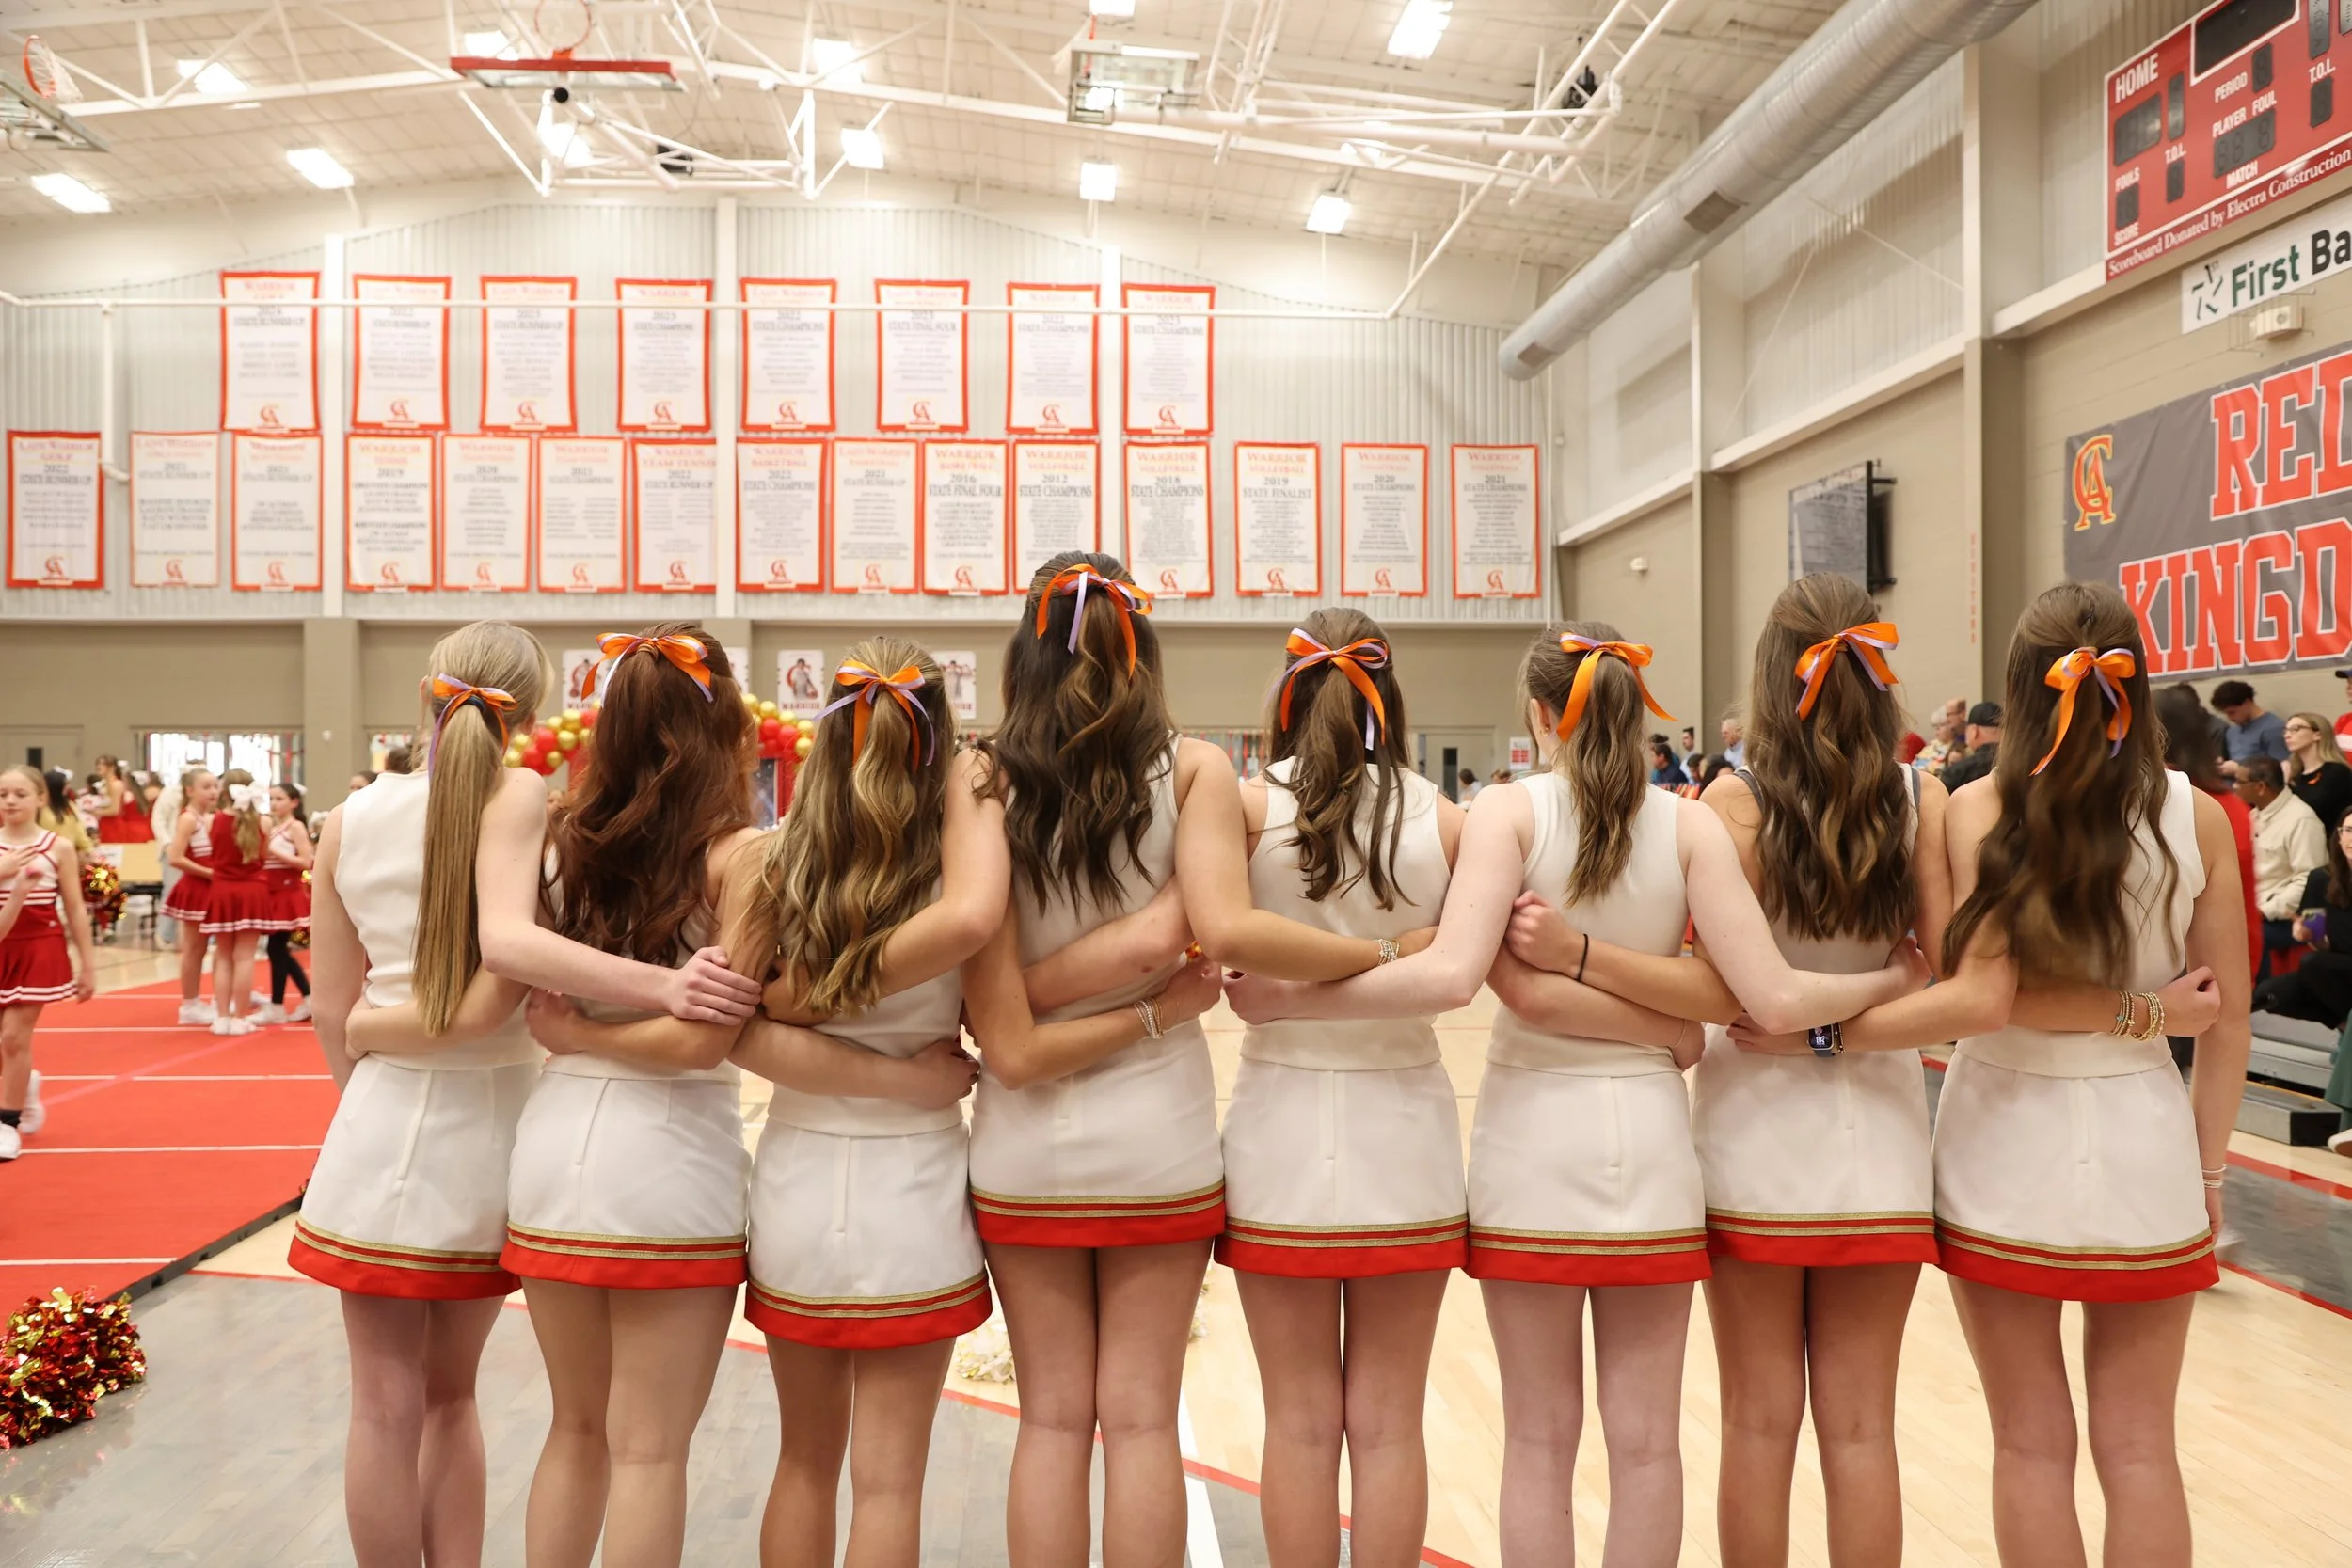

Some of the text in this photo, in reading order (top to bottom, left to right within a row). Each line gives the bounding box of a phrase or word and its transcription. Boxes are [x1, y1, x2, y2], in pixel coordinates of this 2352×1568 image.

[2115, 52, 2159, 103] HOME
[2215, 71, 2248, 103] PERIOD
[2212, 90, 2277, 138] PLAYER FOUL
[2115, 166, 2140, 192] FOULS
[2226, 160, 2258, 189] MATCH
[2108, 150, 2352, 277] Scoreboard Donated by Electra Construction
[2232, 230, 2352, 308] First Ba
[934, 449, 997, 459] WARRIOR
[1025, 449, 1089, 459] WARRIOR
[1136, 451, 1199, 461] WARRIOR
[1248, 451, 1307, 462] WARRIOR
[949, 473, 977, 483] 2016
[1041, 473, 1069, 483] 2012
[1263, 476, 1290, 485] 2019
[768, 481, 816, 491] CHAMPIONS
[929, 484, 1003, 498] STATE FINAL FOUR
[1019, 484, 1093, 498] STATE CHAMPIONS
[1131, 484, 1204, 498] STATE CHAMPIONS
[1375, 483, 1416, 492] CHAMPIONS
[1486, 483, 1527, 492] CHAMPIONS
[1242, 487, 1312, 499] STATE FINALIST
[2119, 517, 2352, 677] KINGD
